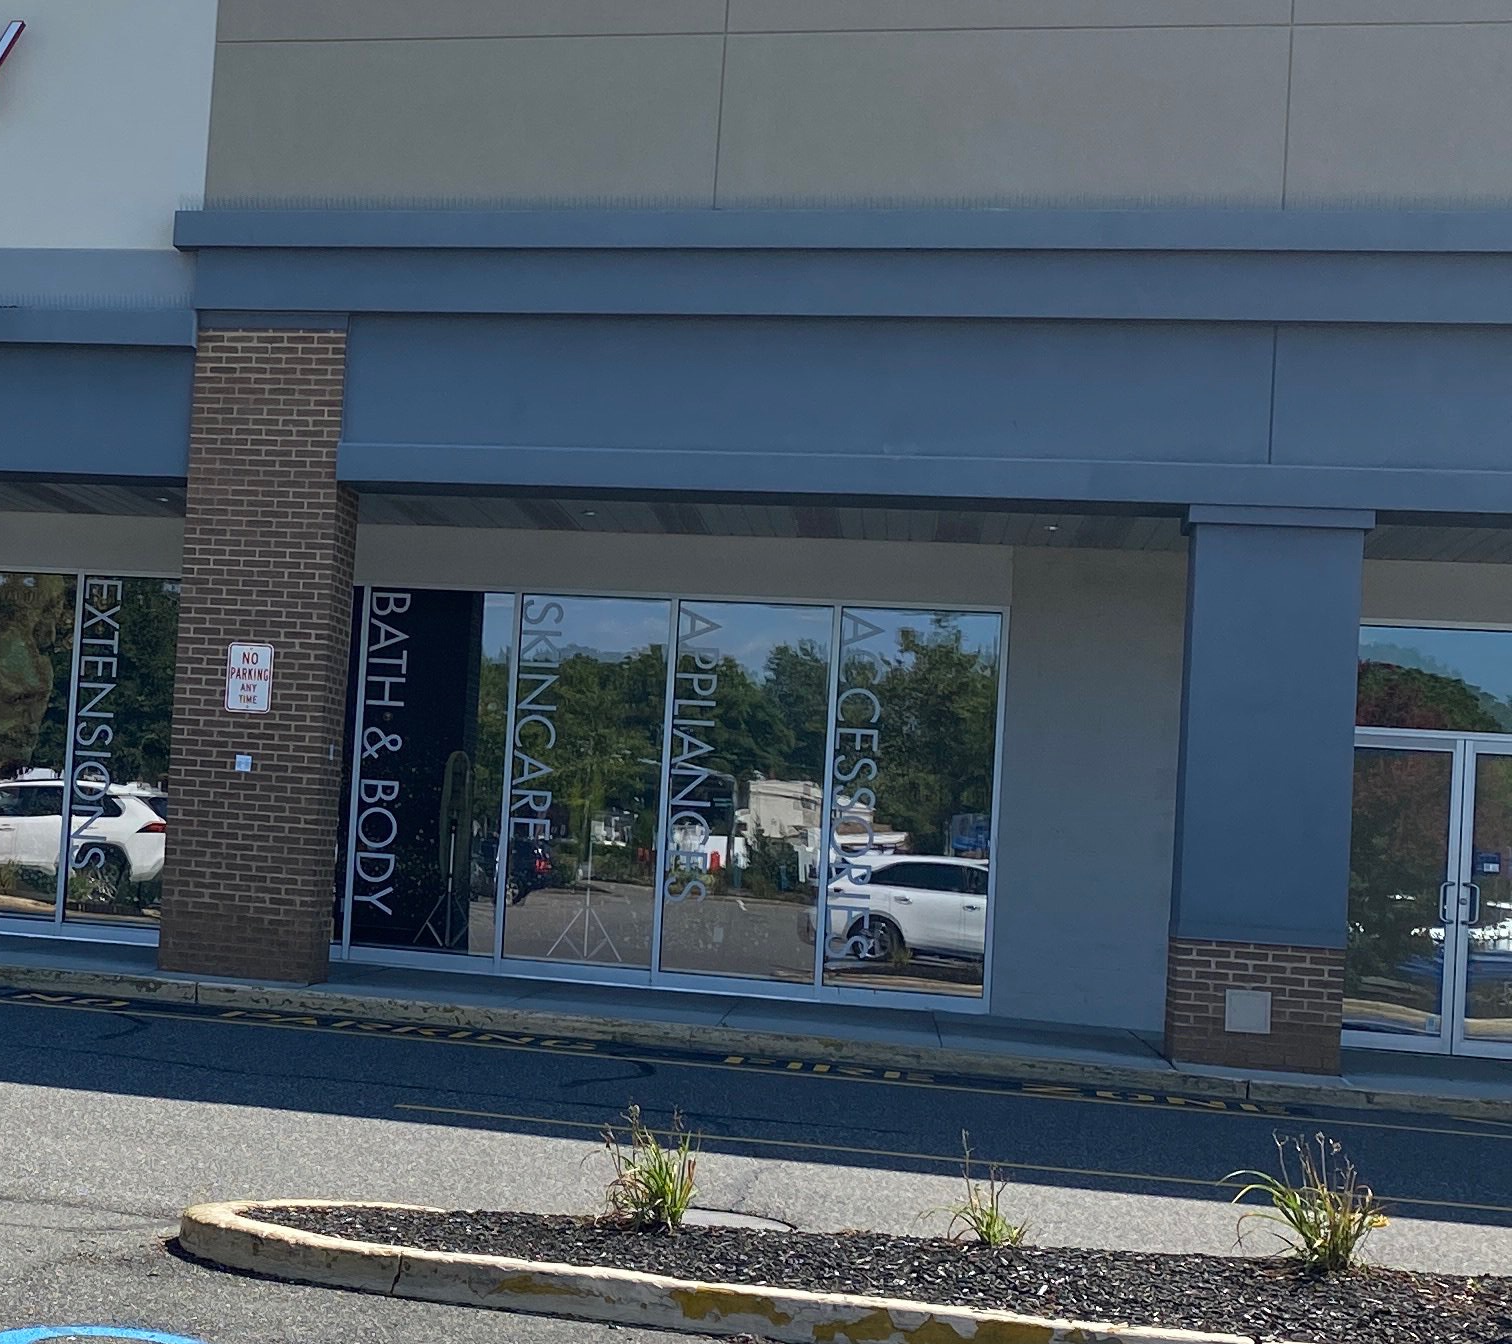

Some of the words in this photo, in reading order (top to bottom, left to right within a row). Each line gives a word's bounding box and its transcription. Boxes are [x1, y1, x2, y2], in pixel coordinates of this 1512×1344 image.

[230, 667, 269, 681] PARKING
[240, 683, 257, 693] ANY
[241, 652, 259, 665] NO
[368, 592, 411, 707] BATH
[70, 579, 123, 870] EXTENSIONS
[239, 694, 257, 704] TIME
[510, 599, 565, 841] SKINCARE
[363, 726, 402, 759] &
[664, 607, 723, 903] APPLIANCES
[825, 611, 886, 958] ACCESSORIES
[354, 778, 400, 916] BODY
[11, 993, 130, 1007] NO
[219, 1010, 595, 1051] PARKING
